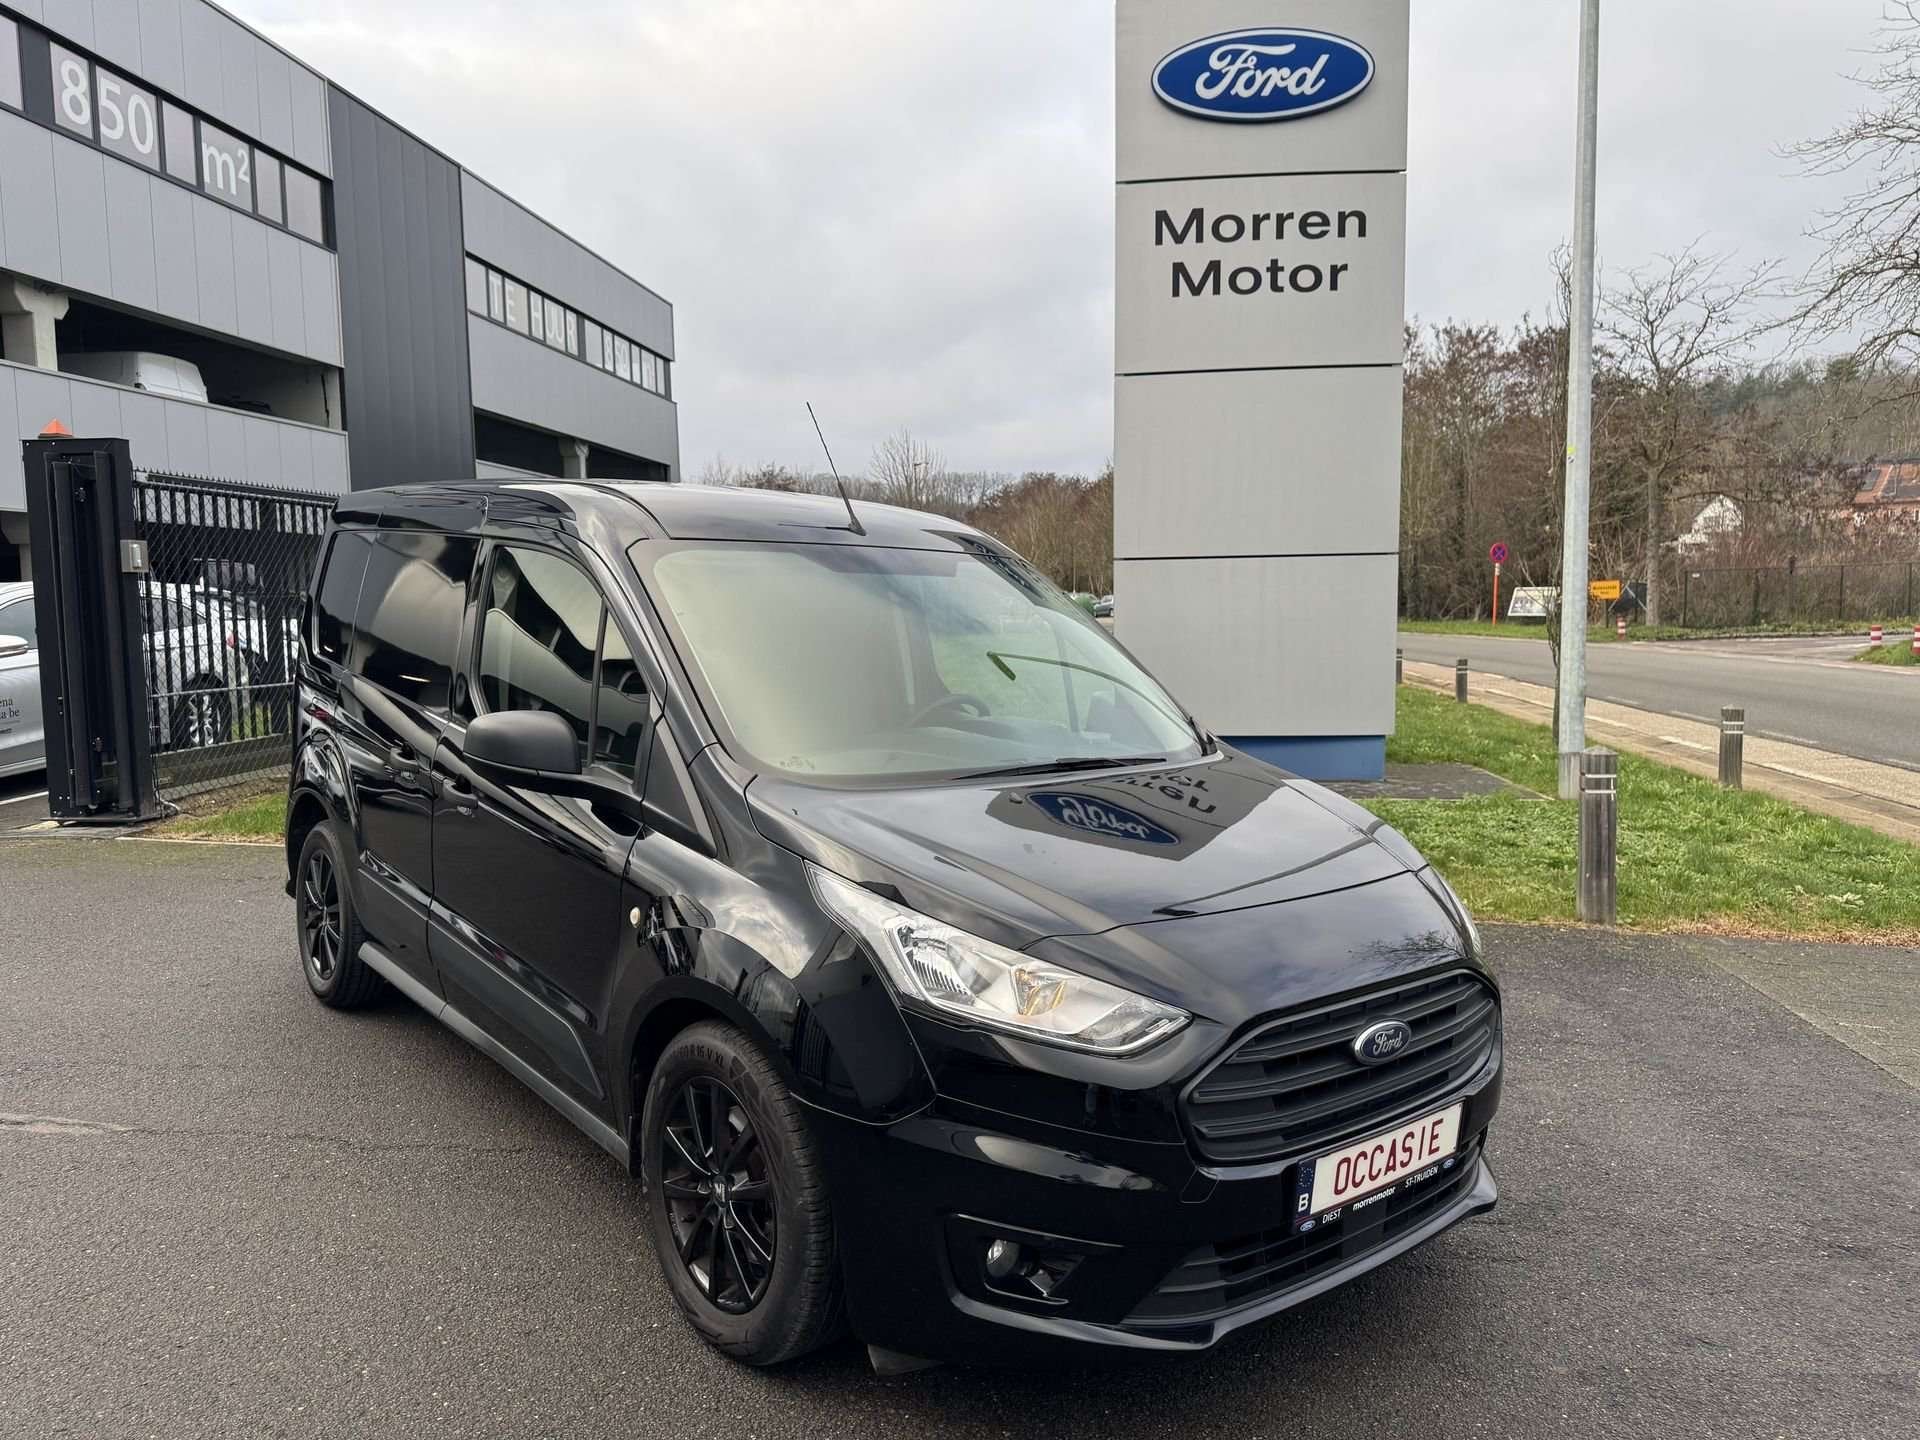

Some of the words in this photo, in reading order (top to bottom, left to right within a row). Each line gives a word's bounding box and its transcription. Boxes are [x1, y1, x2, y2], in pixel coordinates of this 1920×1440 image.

[1195, 43, 1330, 100] Ford
[59, 59, 155, 154] 850
[1154, 207, 1367, 246] Morren
[1171, 258, 1349, 298] Motor
[1372, 1028, 1403, 1056] Ford
[1333, 1118, 1444, 1196] OCCASIE
[1297, 1193, 1309, 1212] B
[1322, 1208, 1342, 1224] DIEST
[1352, 1186, 1396, 1211] morrenmotor
[1405, 1165, 1439, 1189] ST-TRUIDEN
